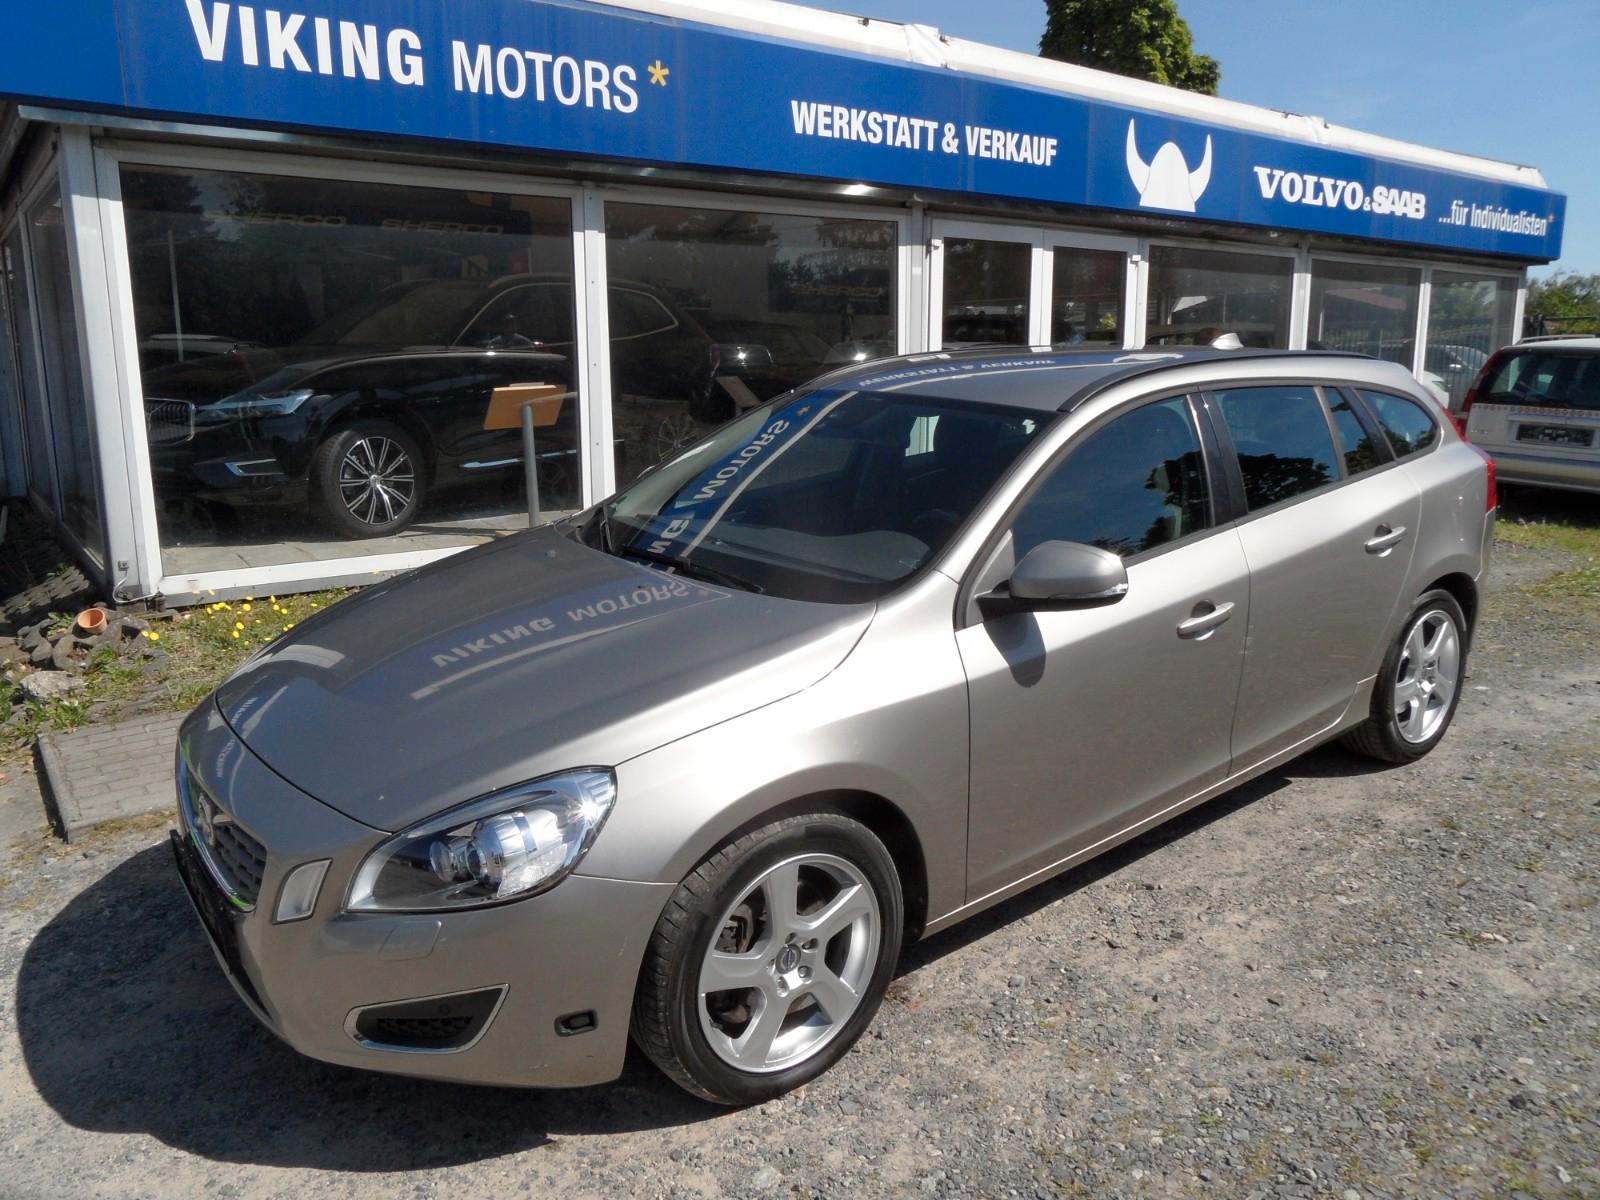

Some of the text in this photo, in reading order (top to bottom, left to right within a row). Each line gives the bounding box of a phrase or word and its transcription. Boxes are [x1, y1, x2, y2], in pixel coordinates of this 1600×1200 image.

[185, 0, 639, 114] VIKING MOTORS
[791, 99, 1058, 167] WERKSTATT & VERKAUF
[1253, 166, 1364, 211] VOLVO
[1371, 185, 1426, 220] SAAB
[1439, 200, 1548, 236] ...für Individualisten
